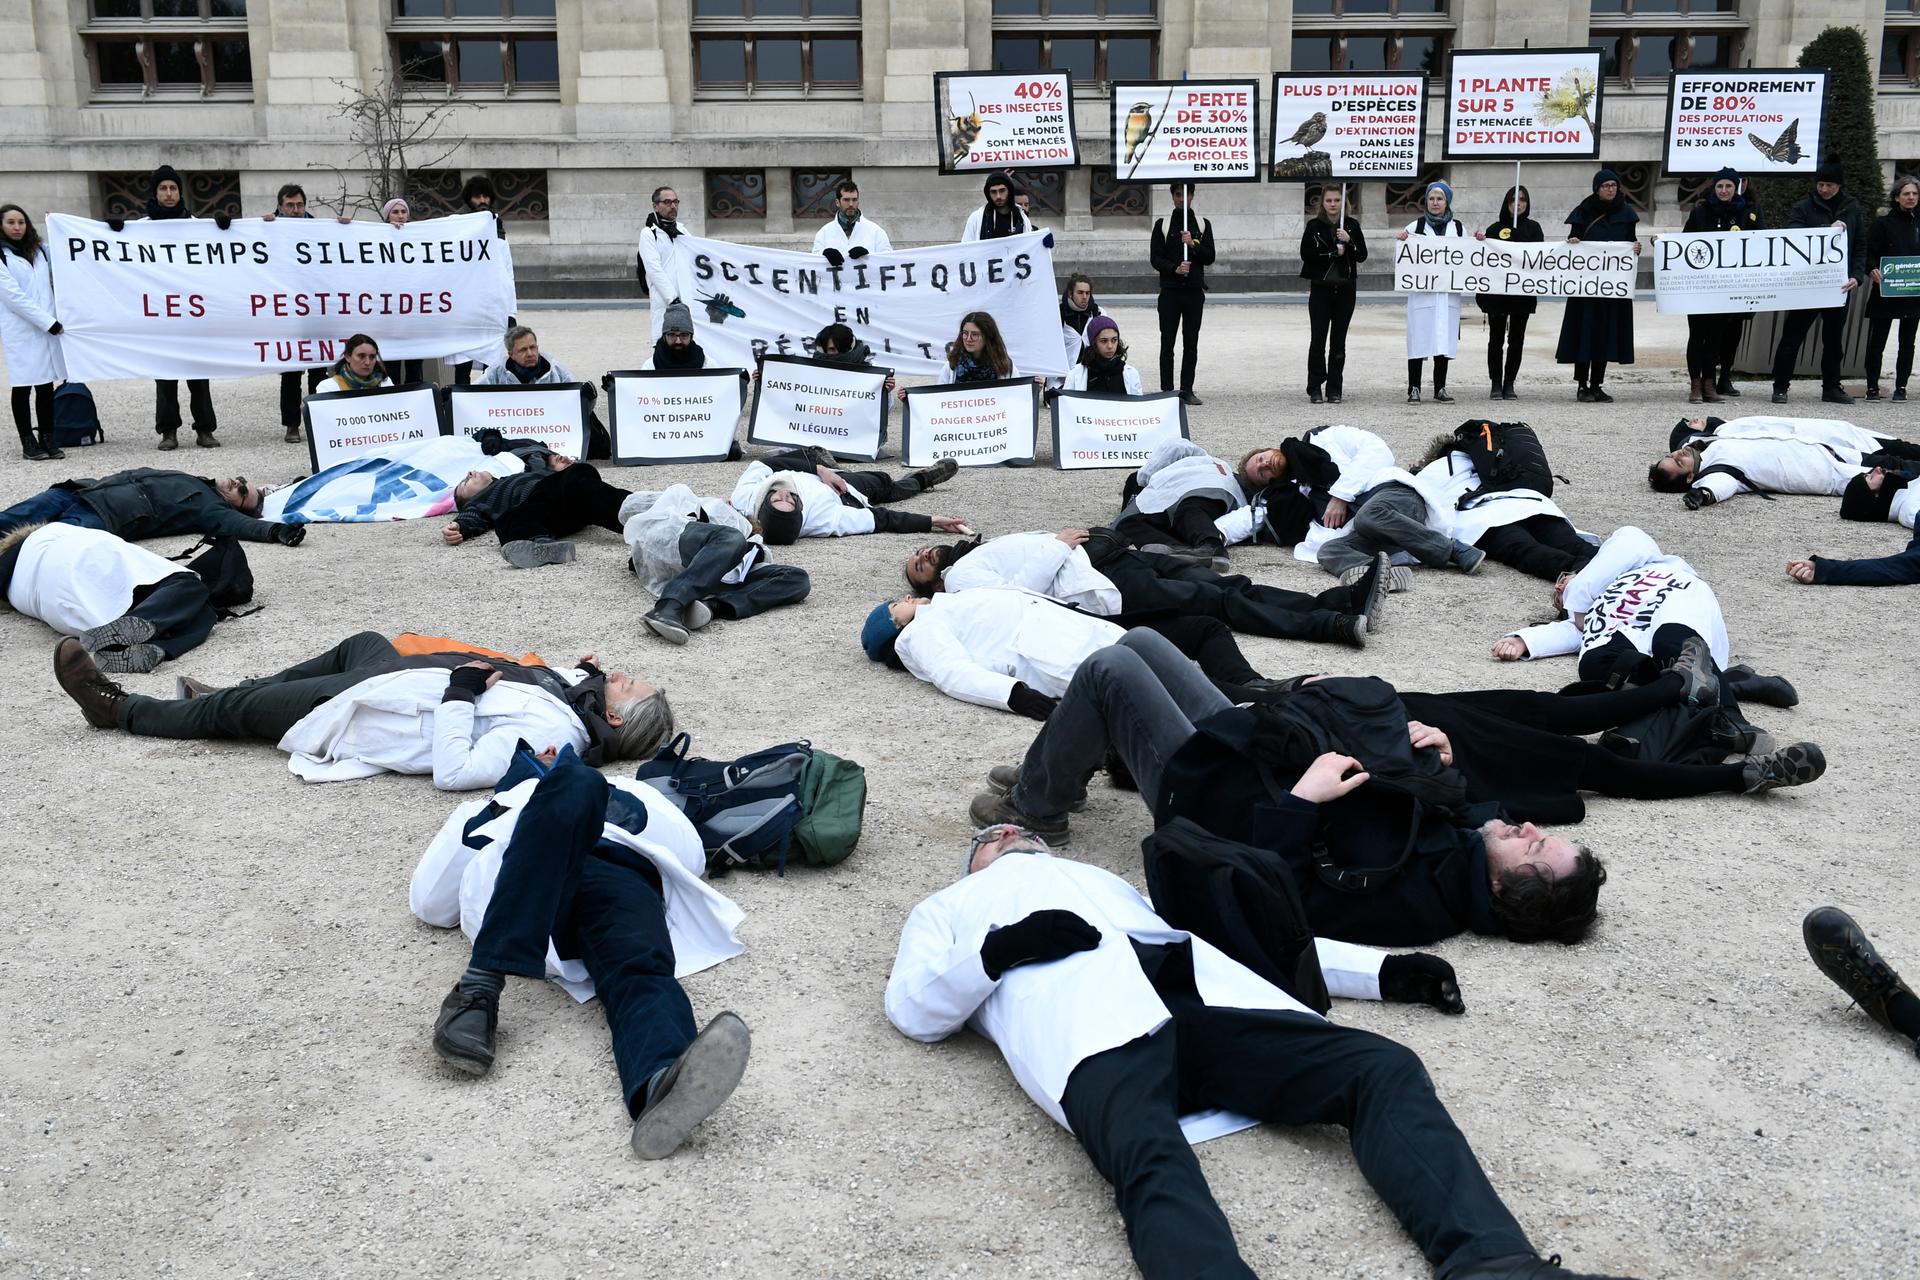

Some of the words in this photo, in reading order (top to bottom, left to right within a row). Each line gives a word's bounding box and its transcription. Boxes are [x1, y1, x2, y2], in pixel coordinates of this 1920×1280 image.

[1015, 82, 1061, 99] 40%
[1284, 85, 1322, 96] PLUS
[1327, 85, 1348, 96] D'1
[1353, 85, 1417, 96] MILLION
[1459, 79, 1465, 92] 1
[1472, 78, 1551, 93] PLANTE
[1682, 82, 1816, 93] EFFONDREMENT
[1188, 93, 1247, 106] PERTE
[1332, 98, 1416, 111] D'ESPÈCES
[1458, 99, 1497, 112] SUR
[1503, 99, 1513, 112] 5
[1681, 97, 1707, 110] DE
[1713, 96, 1755, 110] 80%
[980, 104, 1002, 113] DES
[1006, 102, 1062, 113] INSECTES
[1036, 115, 1063, 123] DANS
[1178, 110, 1201, 123] DE
[1208, 110, 1247, 123] 30%
[1369, 115, 1415, 123] DANGER
[1480, 116, 1532, 126] MENACÉE
[1028, 126, 1064, 134] MONDE
[1336, 127, 1415, 135] D'EXTINCTION
[987, 139, 1014, 147] SONT
[1018, 137, 1066, 145] MENACÉS
[1171, 138, 1247, 147] D'OISEAUX
[1456, 131, 1580, 144] D'EXTINCTION
[1695, 139, 1708, 147] 30
[1712, 139, 1735, 147] ANS
[971, 148, 1068, 163] D'EXTINCTION
[1168, 151, 1248, 160] AGRICOLES
[1211, 163, 1224, 171] 30
[1350, 161, 1412, 170] DÉCENNIES
[69, 238, 268, 264] PRINTEMPS
[296, 240, 490, 264] SILENCIEUX
[1661, 234, 1843, 271] POLLINIS
[1397, 244, 1463, 265] Alerte
[1471, 247, 1512, 268] des
[1522, 249, 1633, 271] Médecins
[696, 253, 1032, 294] SCIENTIFIQUES
[1402, 274, 1438, 290] sur
[1451, 271, 1490, 292] Les
[1506, 273, 1628, 297] Pesticides
[143, 294, 205, 317] LES
[251, 292, 451, 316] PESTICIDES
[835, 307, 870, 324] EN
[767, 380, 791, 390] SANS
[794, 384, 877, 400] POLLINISATEURS
[638, 397, 649, 405] 70
[652, 397, 660, 405] %
[664, 397, 681, 405] DES
[685, 396, 713, 404] HAIES
[941, 398, 995, 408] PESTICIDES
[489, 408, 544, 417] PESTICIDES
[795, 404, 805, 412] NI
[809, 406, 843, 416] FRUITS
[336, 418, 347, 426] 70
[350, 416, 366, 425] 000
[368, 411, 409, 423] TONNES
[669, 413, 710, 422] DISPARU
[976, 412, 1006, 423] SANTÉ
[1077, 416, 1092, 424] LES
[1095, 417, 1160, 426] INSECTICIDES
[511, 425, 570, 434] PARKINSON
[789, 422, 799, 430] NI
[803, 423, 848, 436] LÉGUMES
[934, 427, 1008, 442] AGRICULTEURS
[330, 439, 342, 448] DE
[345, 433, 399, 446] PESTICIDES
[401, 432, 406, 441] /
[409, 430, 423, 439] AN
[932, 451, 940, 459] &
[943, 443, 1007, 458] POPULATION
[1072, 451, 1099, 459] TOUS
[1102, 451, 1118, 459] LES
